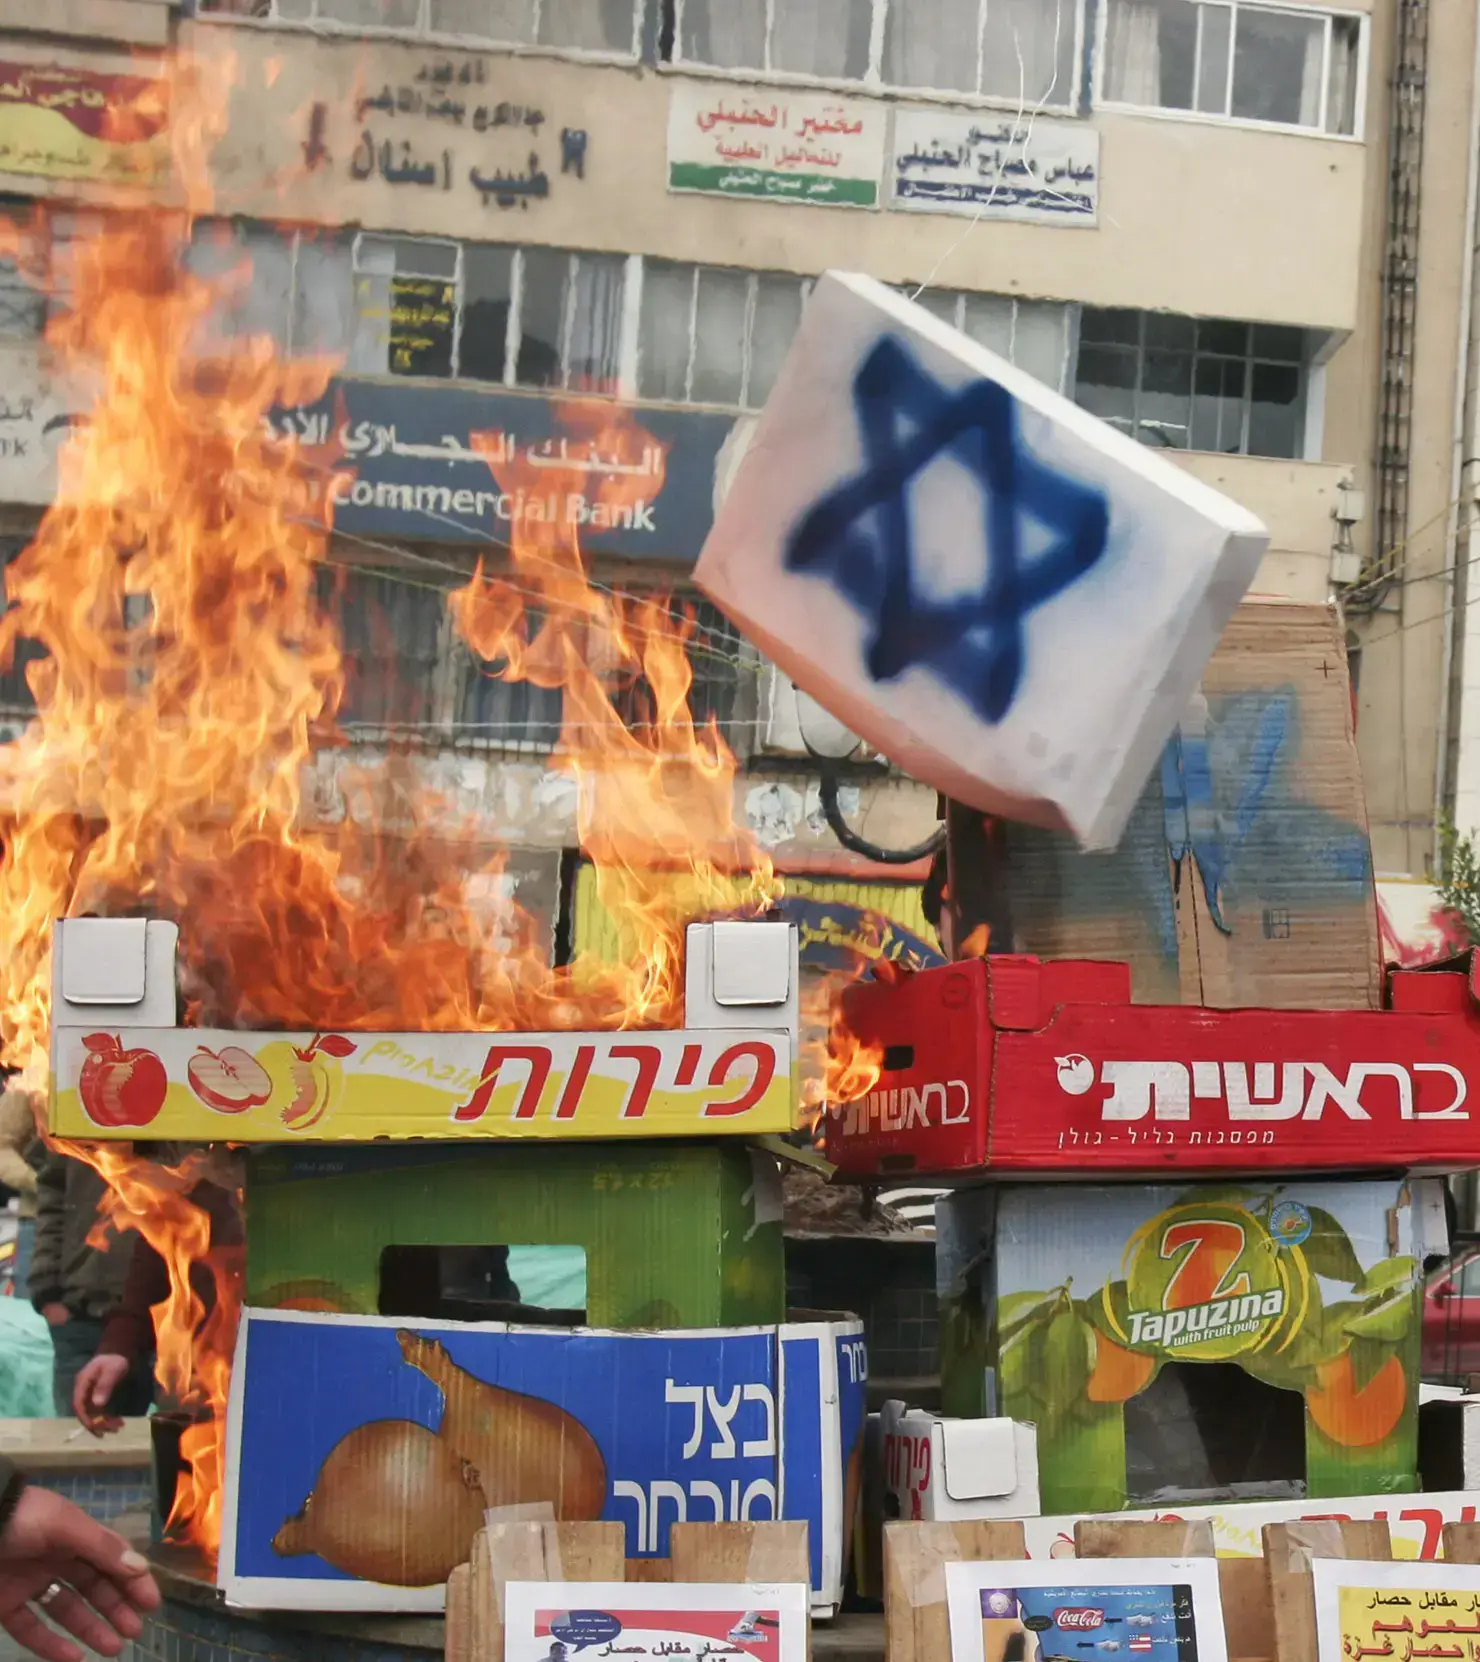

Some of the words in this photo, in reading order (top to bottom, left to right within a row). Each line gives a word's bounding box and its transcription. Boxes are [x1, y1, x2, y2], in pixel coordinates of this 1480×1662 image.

[697, 100, 789, 132] الحنبلي
[796, 107, 863, 142] مختبر
[470, 151, 549, 210] طبيب
[1045, 157, 1095, 186] عباس
[527, 436, 666, 479] البنك
[333, 476, 557, 524] Commercial
[566, 494, 657, 532] Bank
[454, 1041, 776, 1120] פירות
[1102, 1060, 1471, 1122] בראשית
[843, 1079, 970, 1137] בראשית
[1188, 1130, 1276, 1145] מפסגות
[1127, 1289, 1284, 1347] Tapuzina
[1173, 1331, 1201, 1346] with
[1203, 1324, 1232, 1340] fruit
[1233, 1319, 1260, 1336] pulp
[665, 1378, 776, 1459] בצל
[1366, 1591, 1412, 1609] حصار
[1418, 1591, 1458, 1610] مقابل
[597, 1641, 647, 1658] حصار
[651, 1640, 691, 1657] مقابل
[696, 1641, 745, 1658] حصار
[1343, 1633, 1395, 1662] غزة
